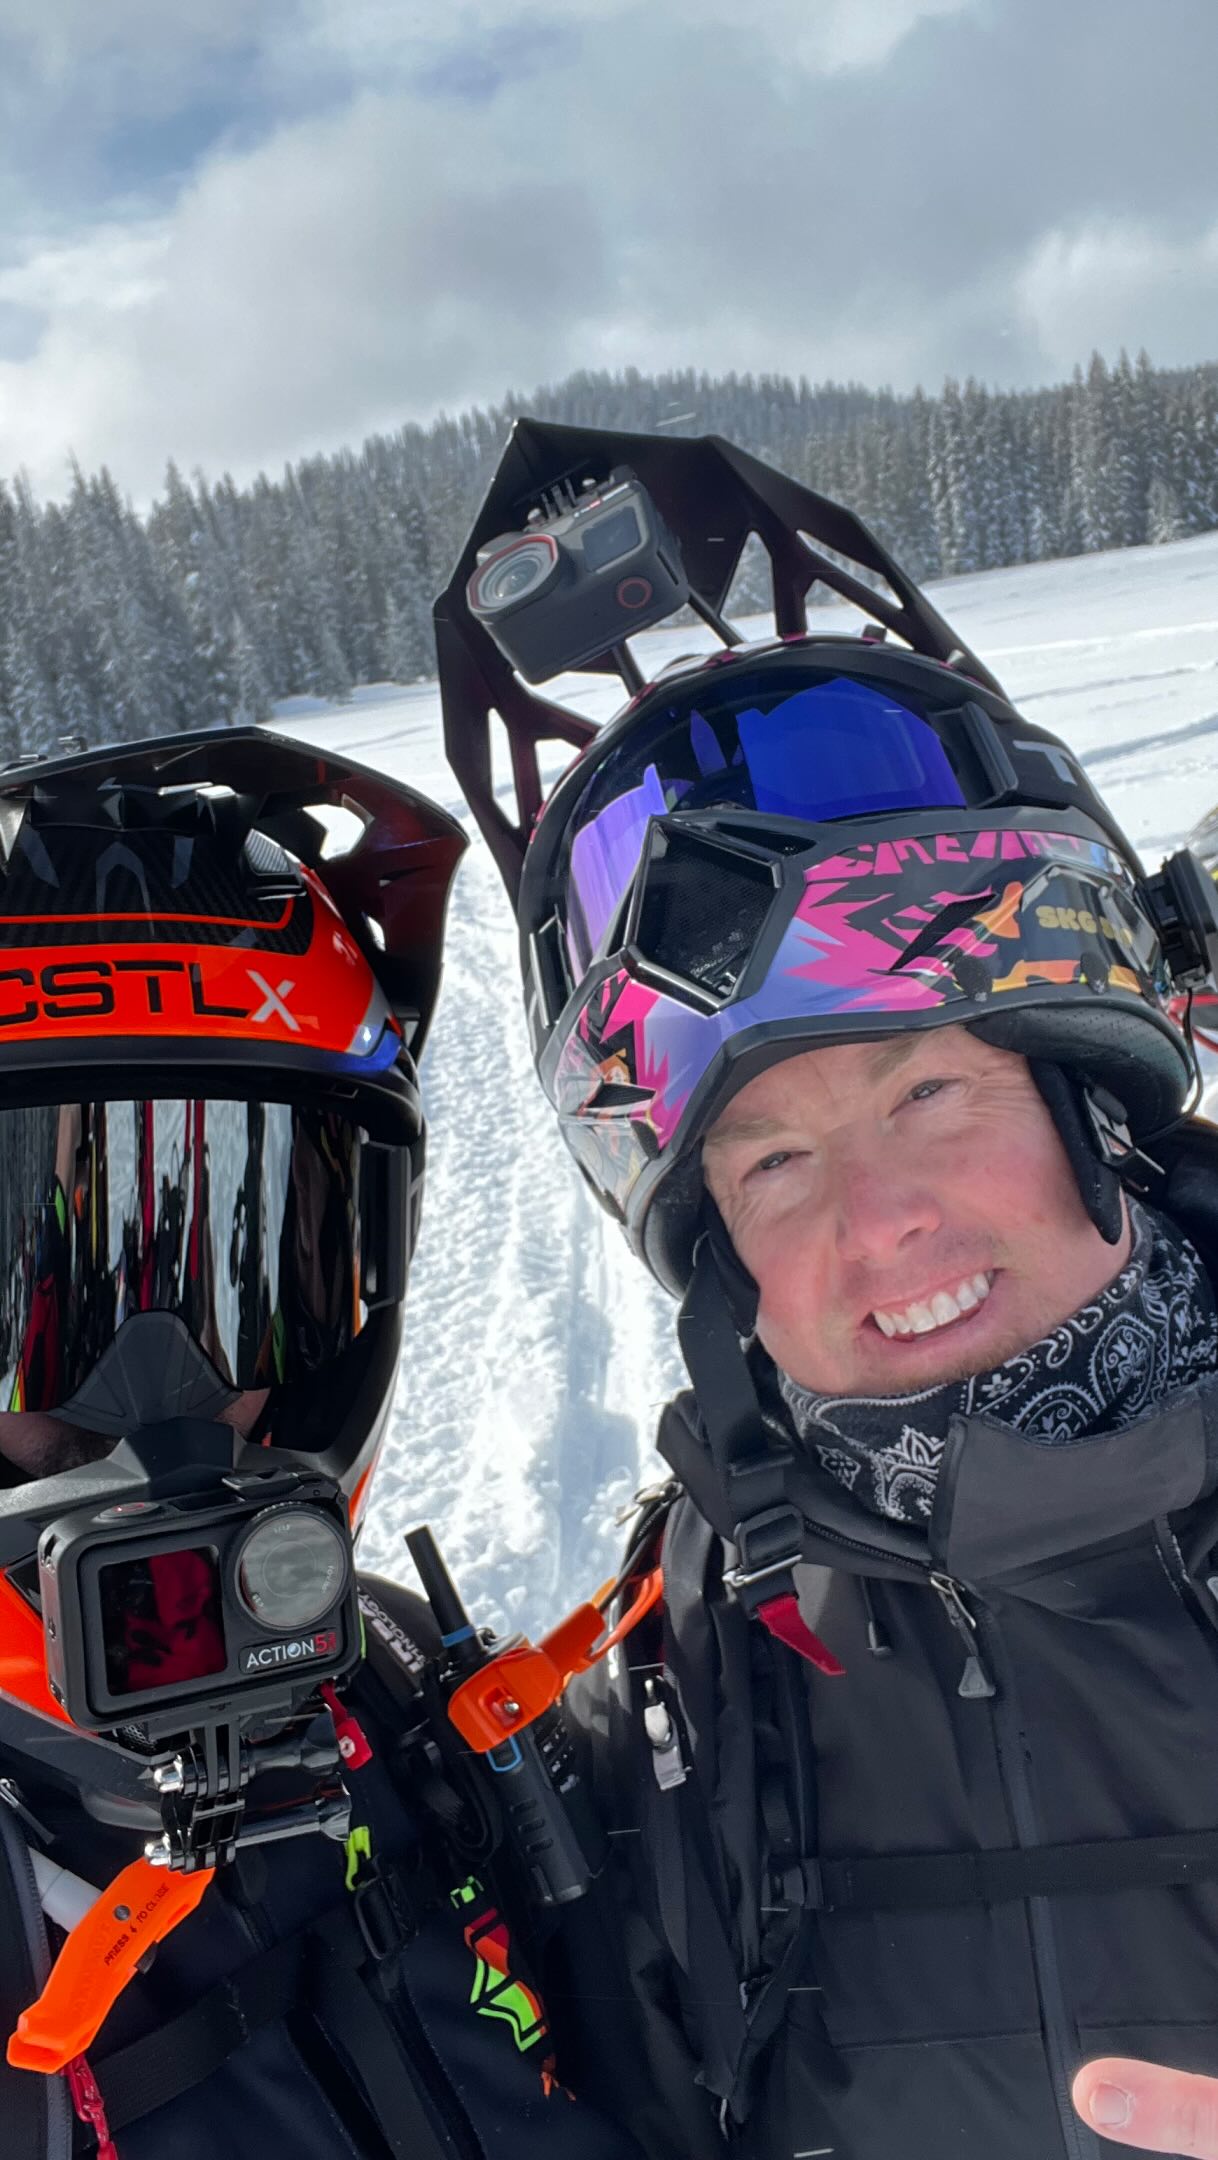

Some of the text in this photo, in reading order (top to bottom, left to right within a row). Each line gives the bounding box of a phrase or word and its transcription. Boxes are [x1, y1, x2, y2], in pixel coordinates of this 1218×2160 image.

[358, 1594, 425, 1667] HNOLOGY
[104, 1934, 129, 1966] PRESS
[136, 1911, 148, 1923] TO
